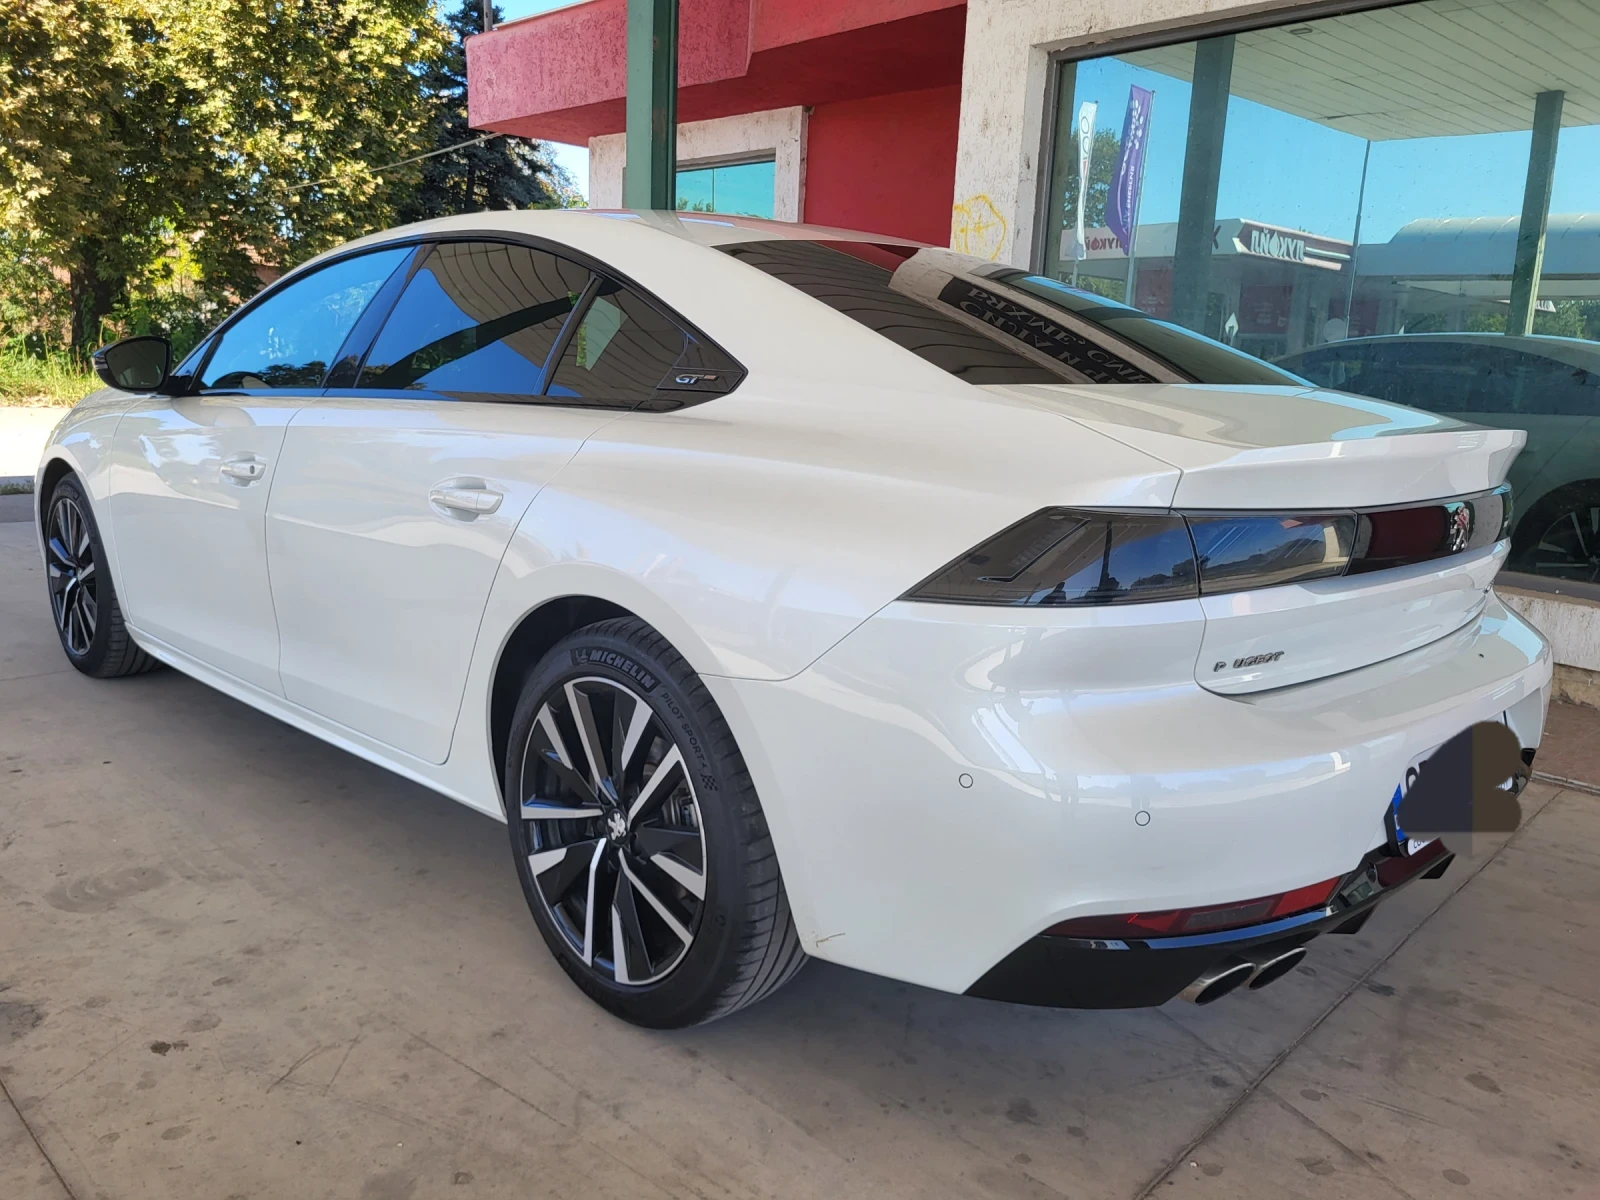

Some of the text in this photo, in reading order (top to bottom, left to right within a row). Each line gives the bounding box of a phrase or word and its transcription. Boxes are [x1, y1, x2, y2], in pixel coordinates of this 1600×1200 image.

[675, 373, 704, 384] GT
[589, 649, 656, 688] MICHELIN
[661, 692, 685, 720] PILOT
[682, 722, 708, 759] SPORT
